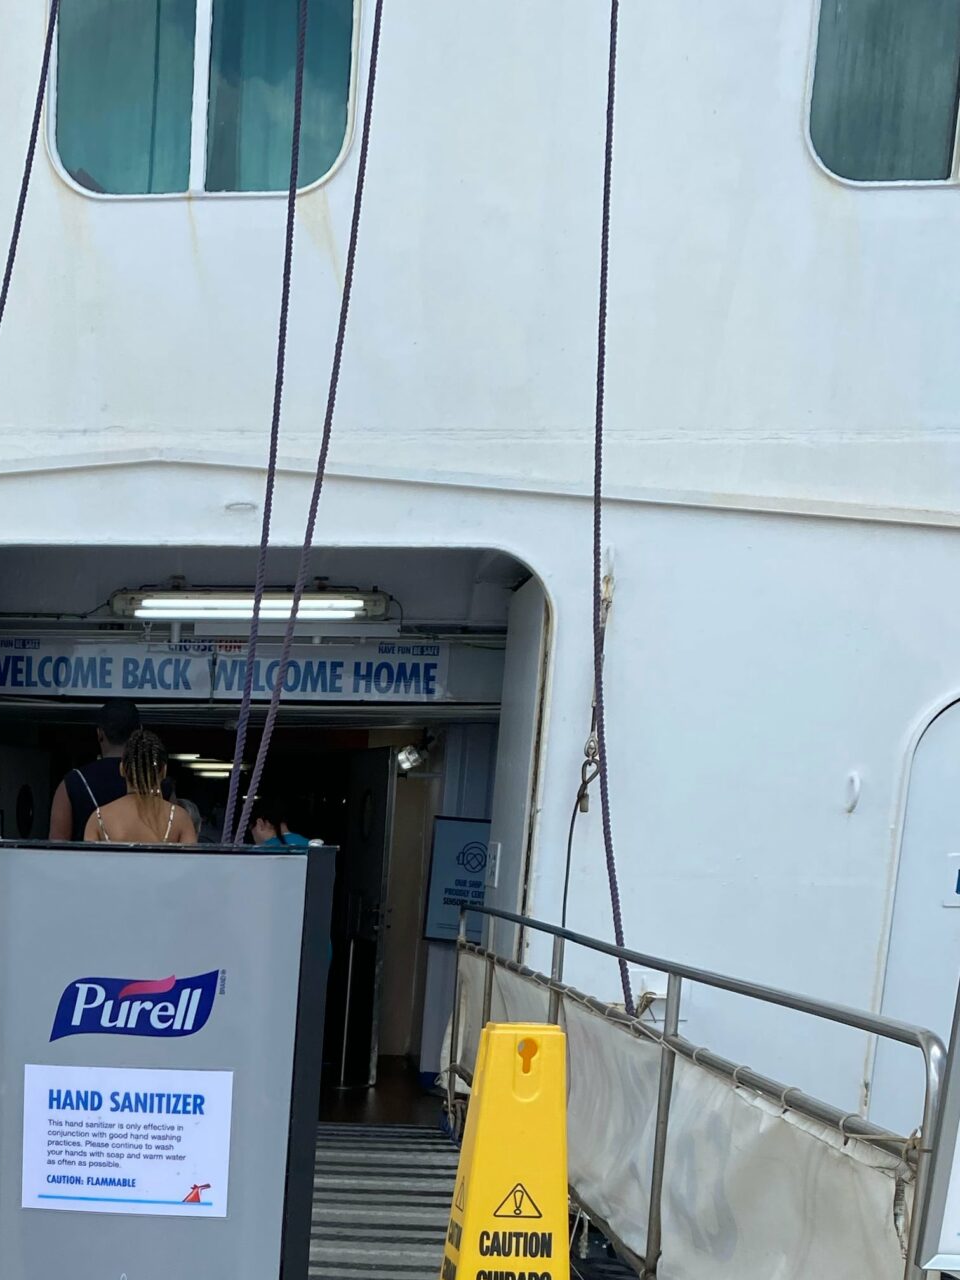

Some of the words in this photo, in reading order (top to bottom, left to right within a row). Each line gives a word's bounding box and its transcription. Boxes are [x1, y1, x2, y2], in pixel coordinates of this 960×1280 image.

[378, 644, 396, 655] HAVE
[121, 656, 192, 691] BACK
[208, 658, 344, 694] WELCOME
[352, 660, 438, 695] HOME
[71, 983, 203, 1031] Purell
[48, 1089, 103, 1111] HAND
[110, 1091, 205, 1115] SANITIZER
[48, 1119, 63, 1127] This
[65, 1119, 83, 1128] hand
[85, 1121, 116, 1129] sanitizer
[126, 1122, 141, 1131] only
[143, 1123, 175, 1132] effective
[47, 1129, 89, 1138] conjunction
[109, 1131, 128, 1140] good
[130, 1132, 148, 1140] hand
[151, 1133, 182, 1142] washing
[47, 1139, 82, 1148] practices.
[85, 1140, 109, 1148] Please
[111, 1141, 143, 1150] continue
[145, 1142, 152, 1150] to
[154, 1143, 174, 1151] wash
[47, 1149, 63, 1157] your
[65, 1149, 87, 1157] hands
[89, 1150, 105, 1158] with
[106, 1151, 124, 1160] soap
[126, 1151, 140, 1160] and
[142, 1153, 164, 1161] warm
[165, 1152, 186, 1161] water
[57, 1158, 76, 1167] often
[88, 1160, 122, 1169] possible.
[46, 1174, 84, 1185] CAUTION:
[86, 1176, 136, 1187] FLAMMABLE
[479, 1230, 553, 1258] CAUTION
